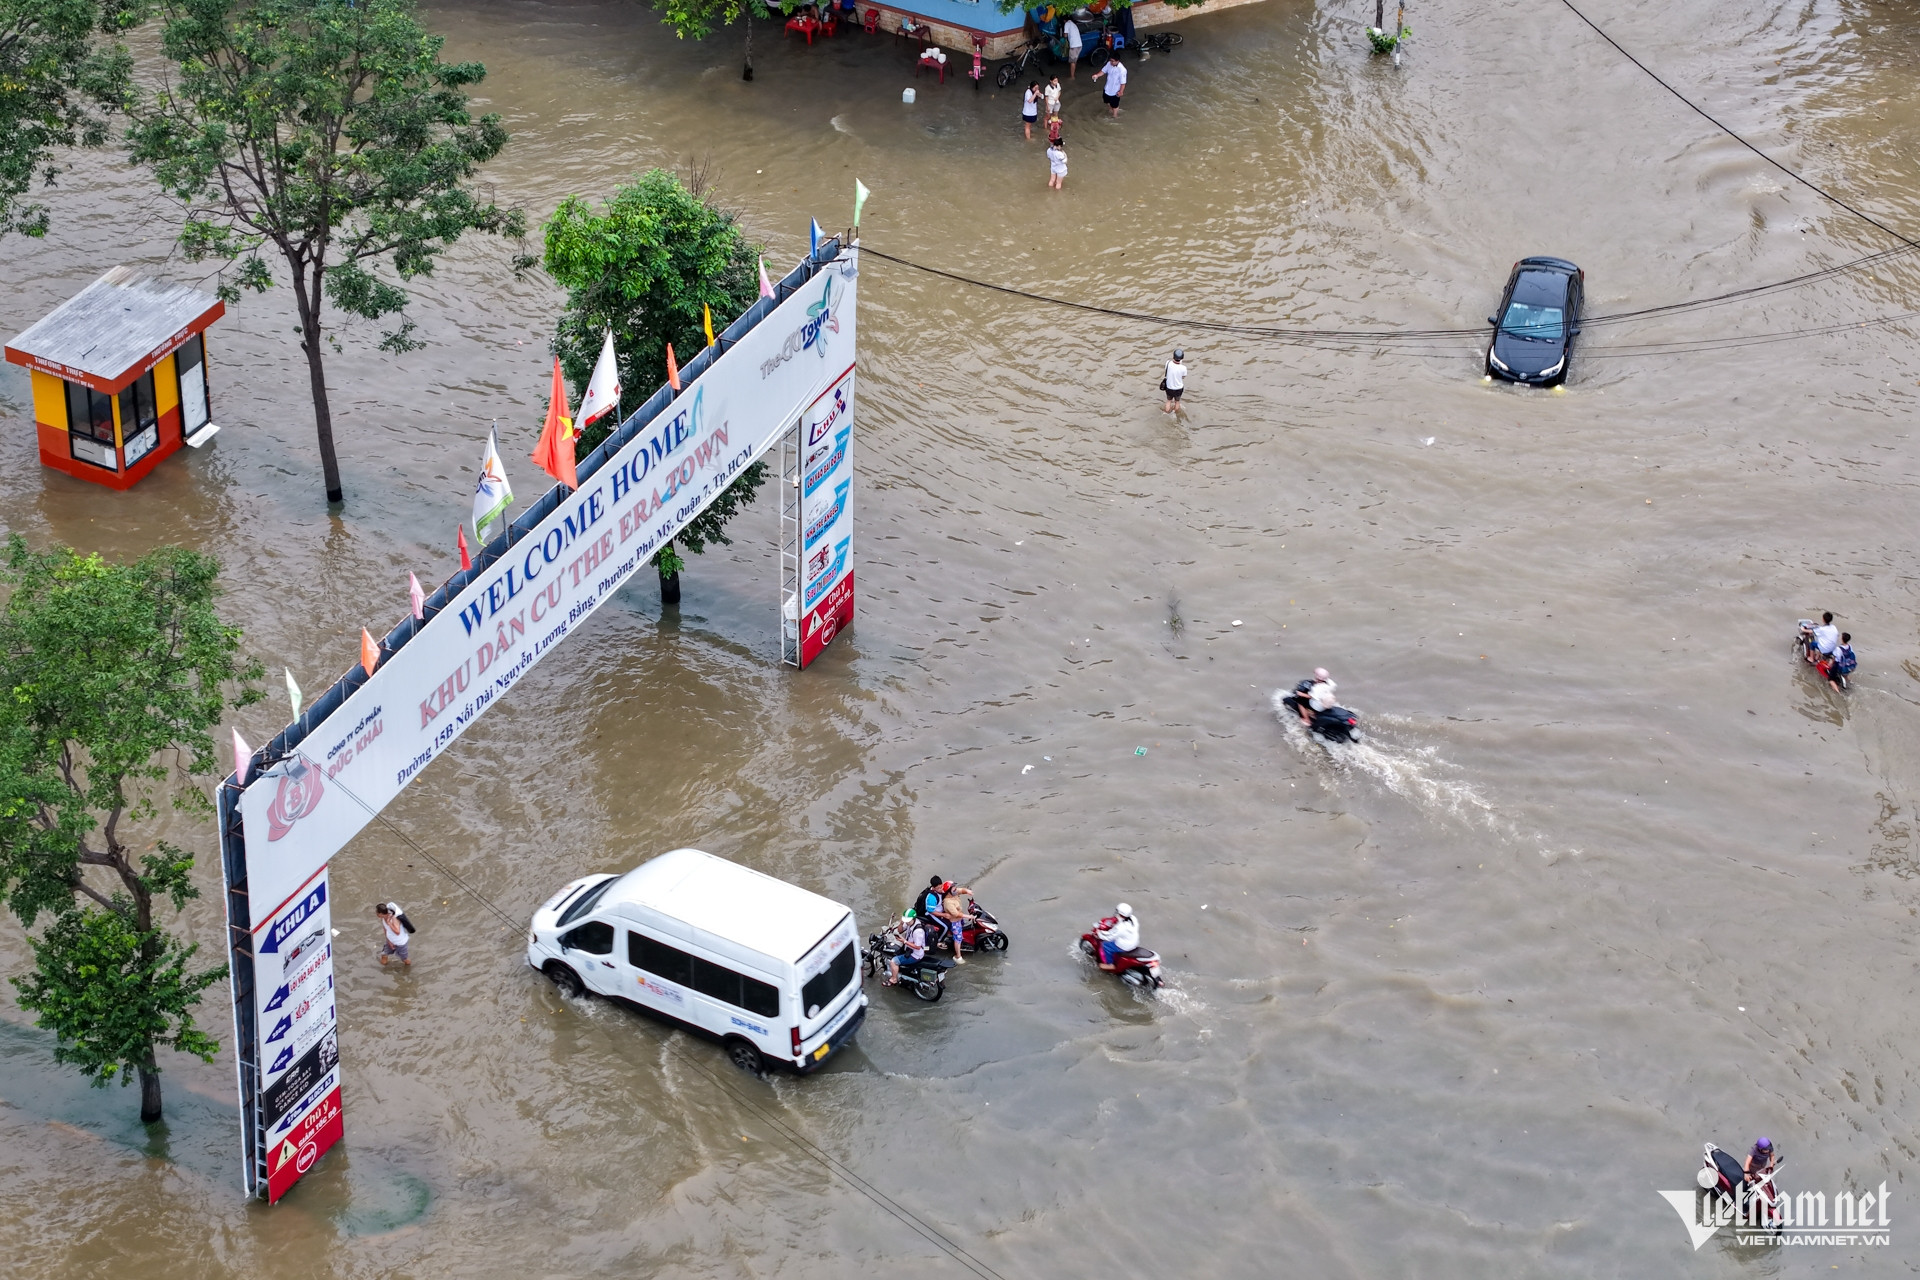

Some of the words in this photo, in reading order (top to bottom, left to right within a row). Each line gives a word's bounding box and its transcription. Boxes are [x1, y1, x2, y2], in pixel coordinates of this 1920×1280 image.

[816, 411, 836, 437] KHU
[459, 487, 605, 637] WELCOME
[611, 409, 690, 506] HOME
[418, 657, 471, 731] KHU
[475, 608, 525, 677] DÂN
[530, 568, 566, 623] CƯ
[568, 528, 615, 590] THE
[618, 487, 663, 546] ERA
[665, 420, 729, 502] TOWN
[396, 746, 432, 786] Đường
[434, 723, 454, 750] 15B
[475, 684, 494, 711] Dài
[495, 650, 533, 693] Nguyễn
[534, 619, 568, 657] Lương
[598, 556, 635, 597] Phường
[635, 536, 654, 564] Phú
[676, 494, 701, 524] Quận
[702, 484, 712, 500] 7,
[713, 443, 753, 490] Tp.HCM
[327, 739, 346, 760] CÔNG
[346, 730, 354, 742] TY
[274, 904, 305, 944] KHU
[308, 892, 320, 912] A
[304, 1107, 322, 1129] Chú
